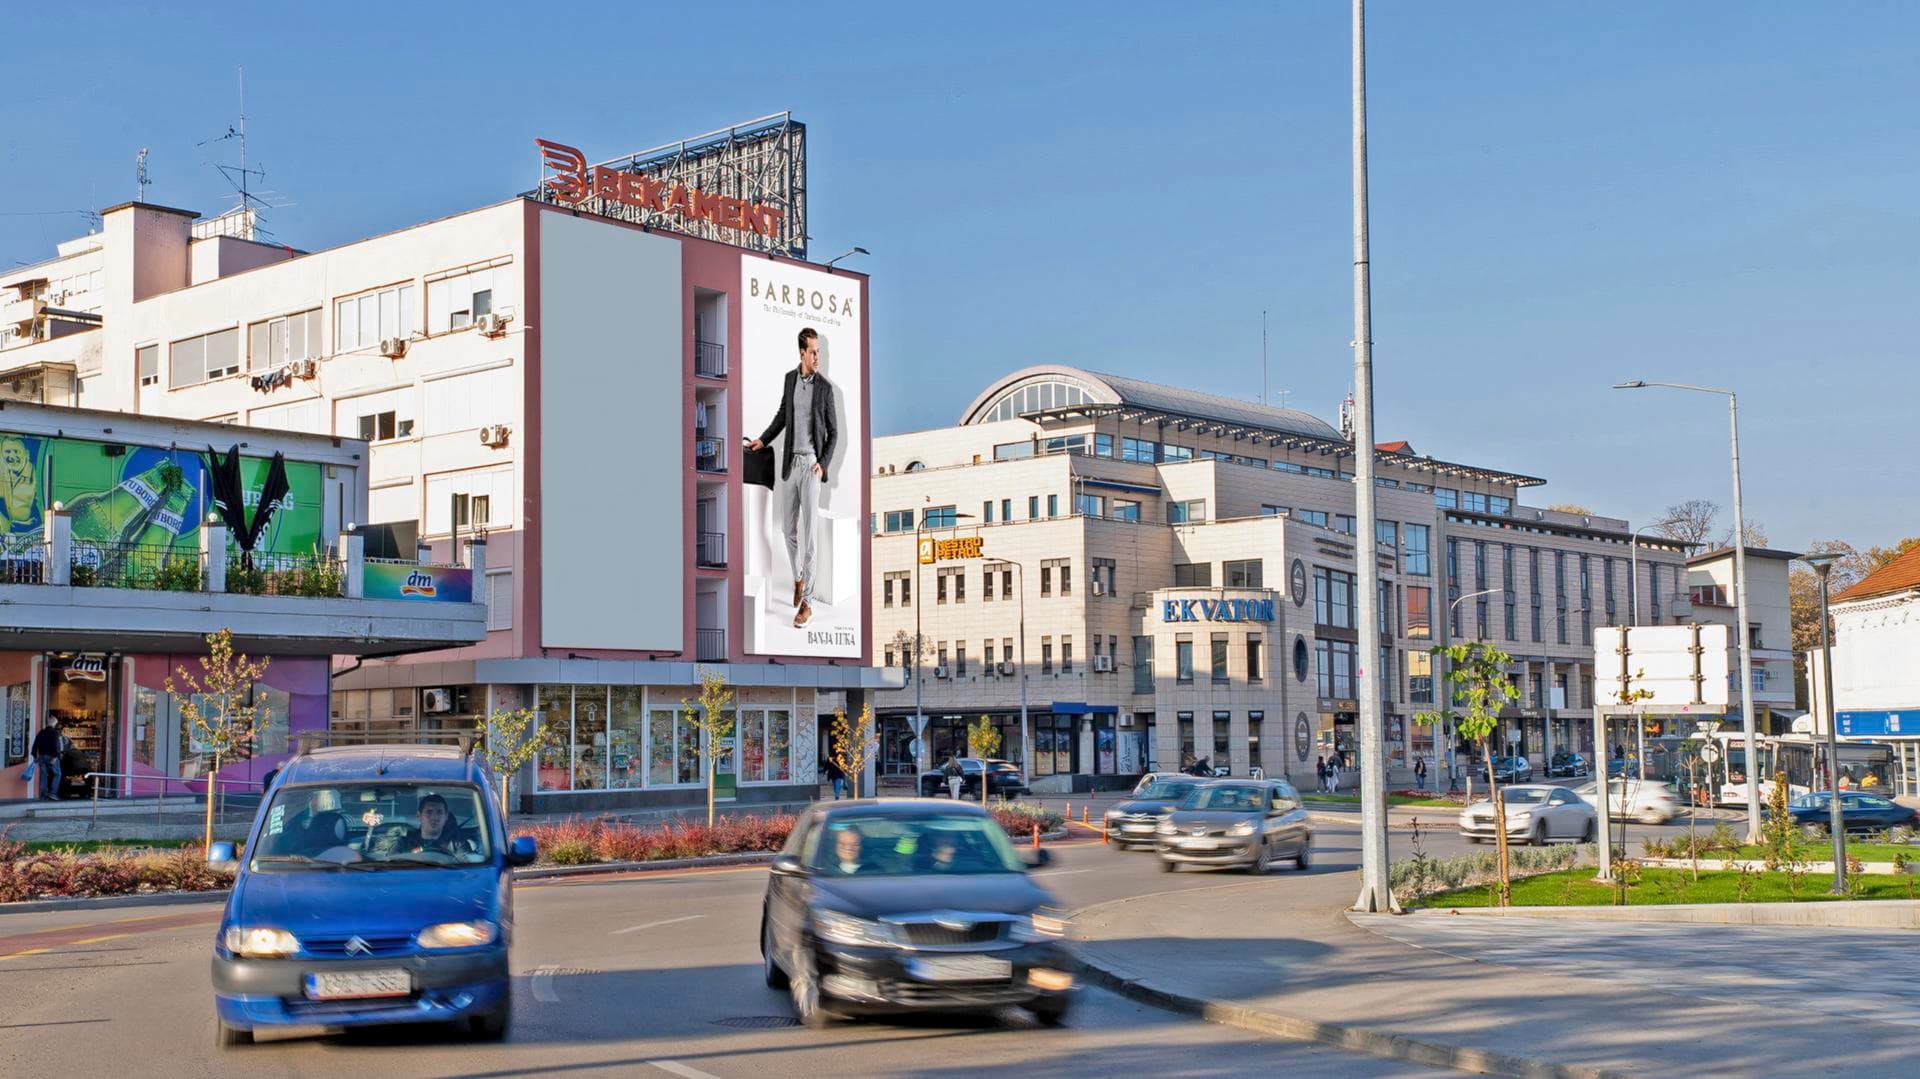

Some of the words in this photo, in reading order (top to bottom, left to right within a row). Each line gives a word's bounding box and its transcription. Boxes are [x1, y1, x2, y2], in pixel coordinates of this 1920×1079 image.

[594, 165, 784, 238] BEKAMENT
[751, 278, 852, 317] BARBOSA
[936, 537, 983, 549] NESTRO
[936, 547, 983, 560] PETROL
[407, 569, 433, 587] dm
[1162, 599, 1275, 622] EKVATOR
[72, 653, 102, 671] dm
